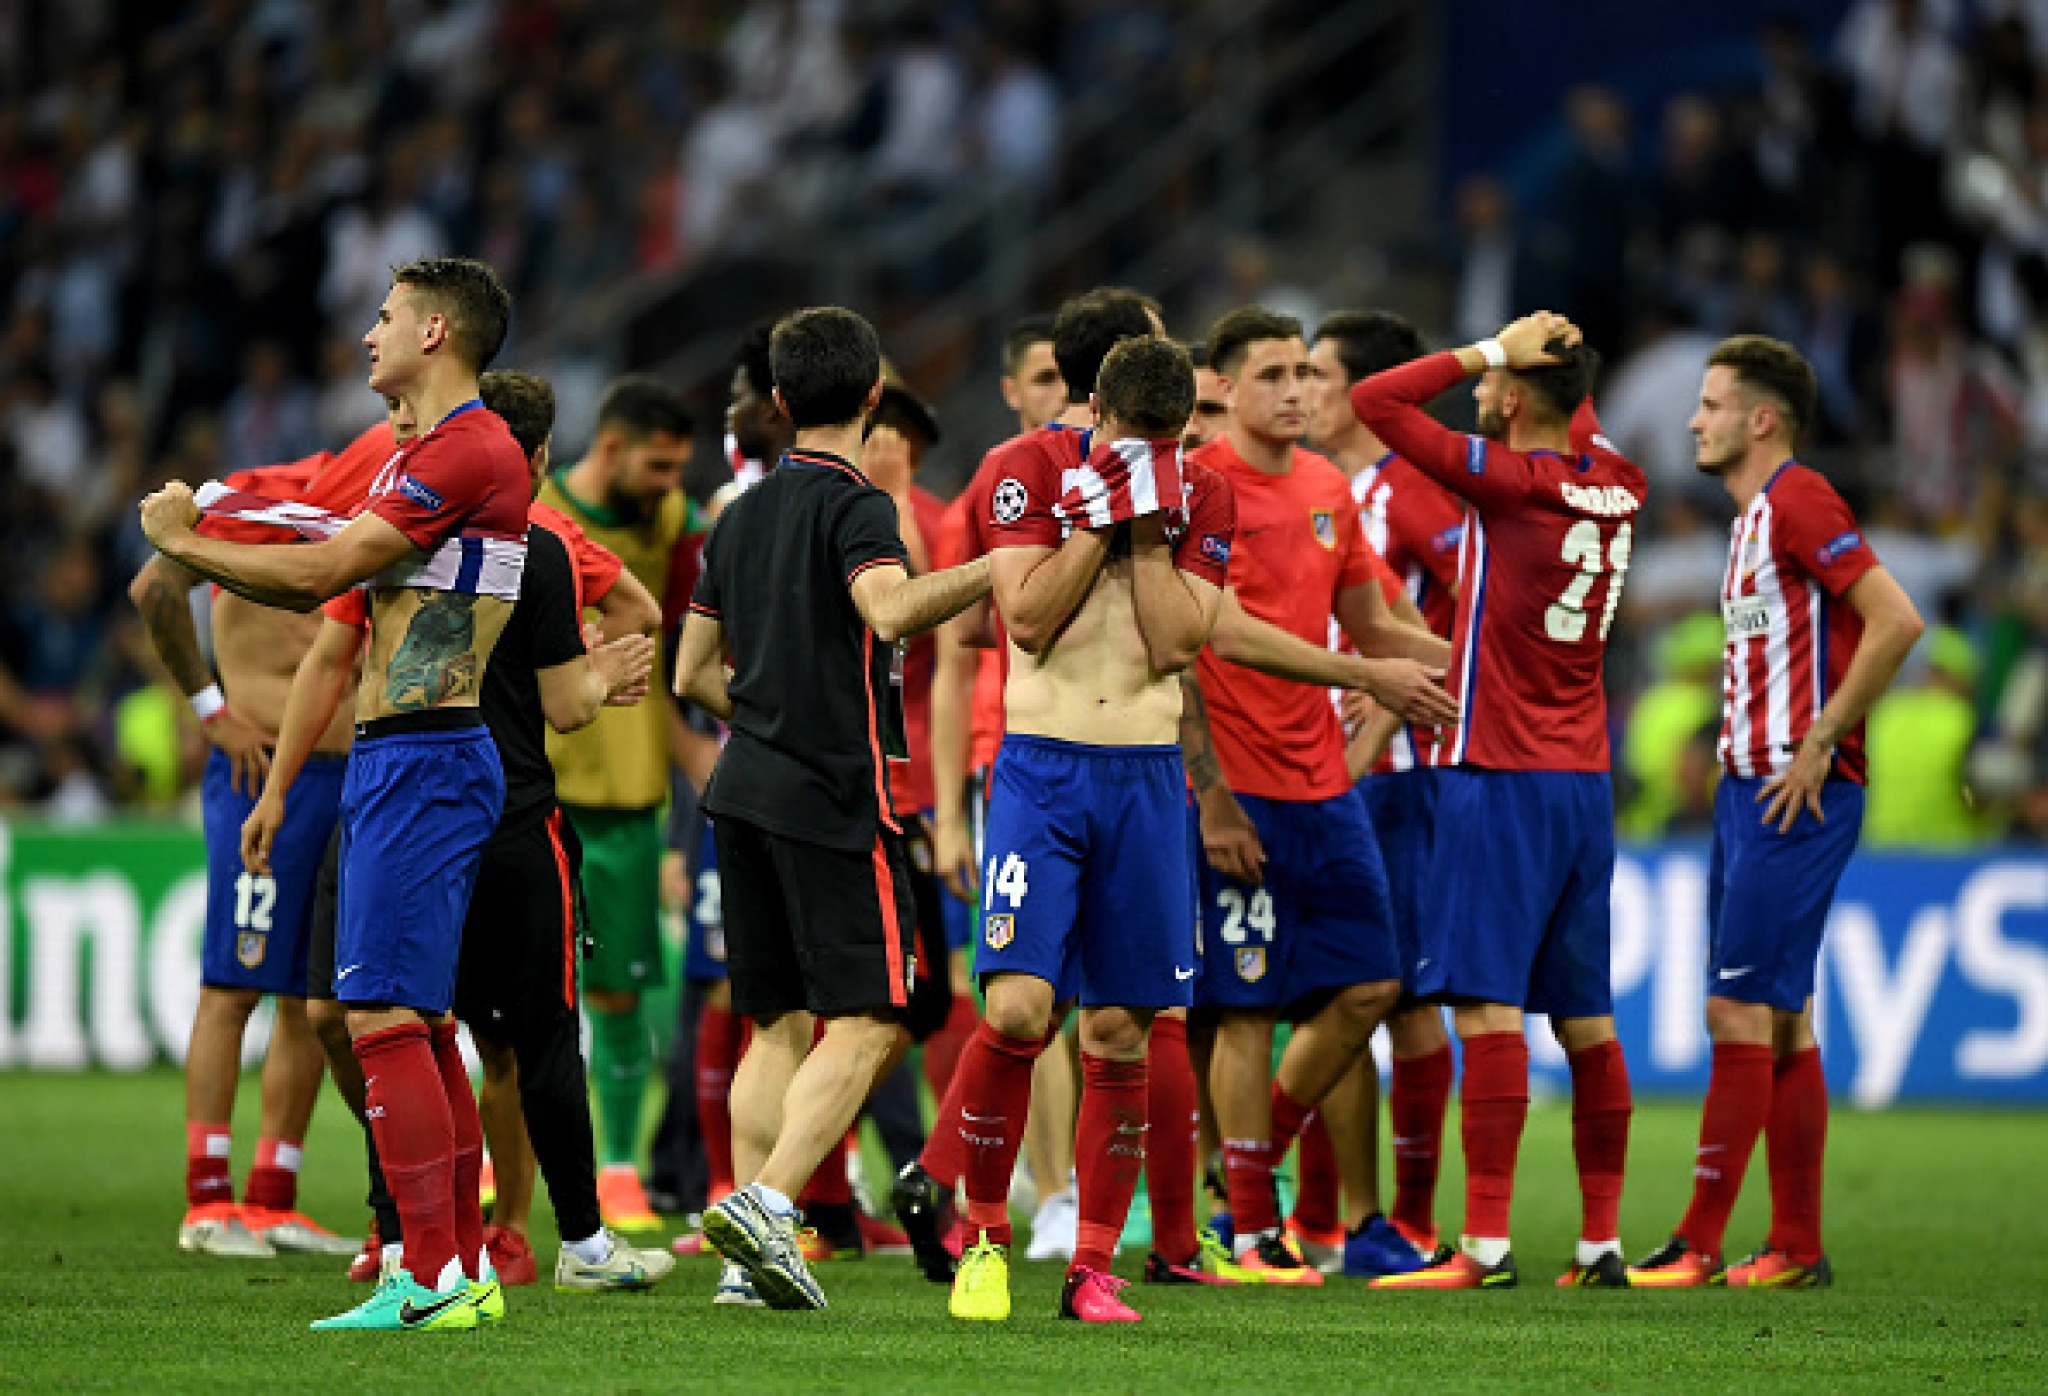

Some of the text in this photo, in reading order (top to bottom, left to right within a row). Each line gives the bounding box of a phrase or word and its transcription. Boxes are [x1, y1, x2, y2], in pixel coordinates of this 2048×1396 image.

[1545, 520, 1632, 642] 21
[234, 872, 277, 931] 12
[985, 852, 1028, 911] 14
[1217, 888, 1276, 944] 24
